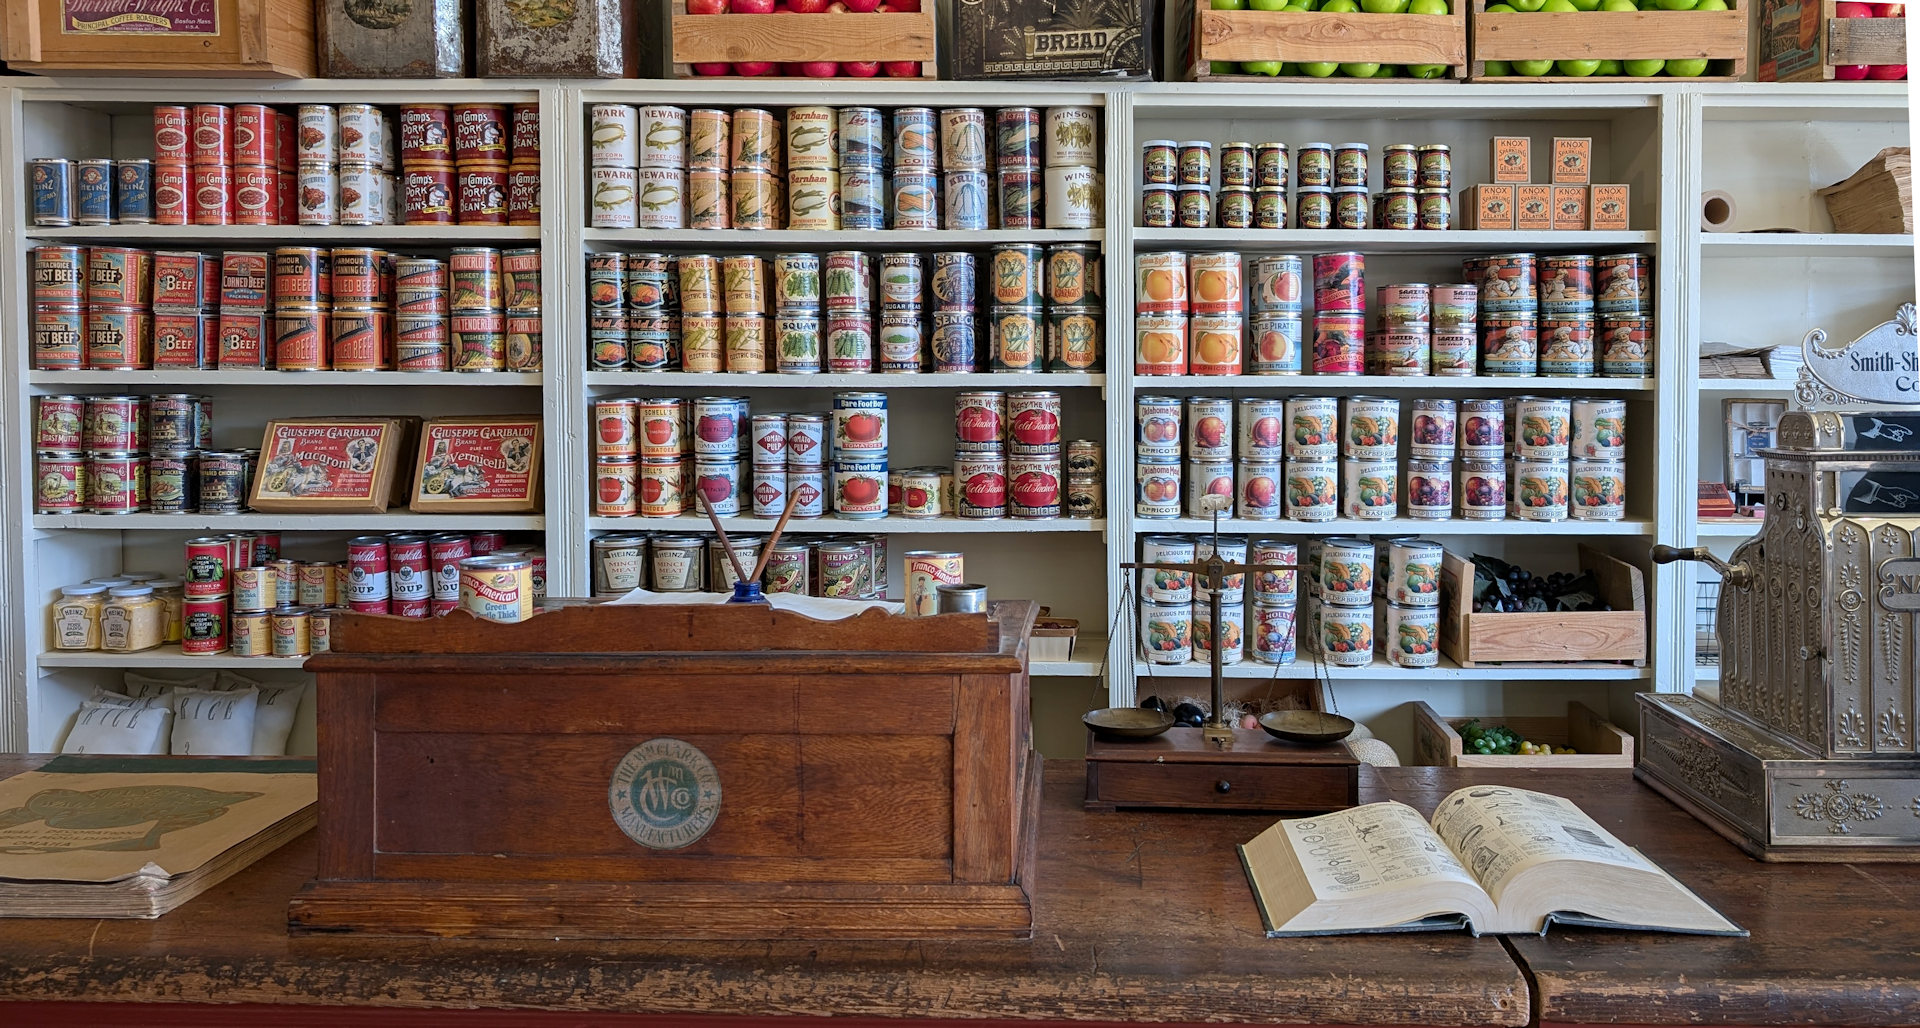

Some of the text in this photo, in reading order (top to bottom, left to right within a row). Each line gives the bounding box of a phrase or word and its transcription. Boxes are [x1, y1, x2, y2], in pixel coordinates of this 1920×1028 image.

[76, 20, 110, 31] PRINCIPAL
[110, 14, 134, 25] COFFEE
[136, 13, 168, 26] ROASTERS
[1036, 31, 1107, 53] BREAD
[463, 110, 488, 125] Camp's
[593, 108, 626, 118] EWARK
[402, 124, 425, 136] PORK
[458, 124, 483, 138] PORK
[456, 135, 483, 151] BEANS
[513, 134, 538, 149] BEANS
[1560, 141, 1584, 149] KNOX
[1499, 149, 1527, 157] SPARKLING
[1558, 150, 1587, 158] SPARKLING
[1000, 156, 1024, 165] SUGAR
[1499, 164, 1526, 172] GELATINE
[1558, 165, 1585, 174] GELATINE
[410, 173, 433, 188] Camp's
[468, 173, 493, 188] Camp's
[406, 186, 428, 200] PORK
[463, 186, 487, 201] PORK
[511, 185, 534, 200] PORK
[1522, 187, 1546, 195] KNOX
[460, 199, 487, 212] BEANS
[1482, 196, 1511, 205] SPARKLING
[1483, 211, 1509, 219] GELATINE
[1521, 211, 1548, 219] GELATINE
[786, 261, 819, 270] SQUAW
[885, 257, 921, 266] PIONEER
[157, 268, 184, 277] CORNED
[1264, 263, 1285, 273] LITTLE
[54, 269, 78, 281] BEEF
[96, 269, 117, 282] BEEF
[166, 275, 195, 290] BEEF.
[223, 276, 265, 288] CORNED BEEF
[782, 322, 817, 330] SQUAW
[882, 317, 918, 326] PIONEER
[1270, 321, 1295, 331] PIRATE
[157, 328, 184, 337] CORNED
[222, 327, 247, 337] CORNED
[51, 331, 75, 344] BEEF
[97, 331, 117, 344] BEEF
[166, 334, 195, 350] BEEF.
[230, 334, 259, 350] BEEF.
[873, 400, 884, 409] Boy
[1417, 401, 1454, 410] JUNE
[1470, 402, 1504, 412] JUNE
[1142, 406, 1170, 415] Oklahoma
[1014, 421, 1033, 430] Cold
[277, 426, 381, 440] GIUSEPPE GARIBALDI
[431, 426, 534, 440] GIUSEPPE GARIBALDI
[764, 434, 783, 442] TOMATO
[58, 434, 80, 443] MUTTON
[105, 434, 127, 443] MUTTON
[300, 438, 323, 446] BRAND
[455, 439, 477, 447] BRAND
[766, 442, 782, 451] PULP
[793, 443, 809, 452] PULP
[1011, 439, 1060, 453] Tomatoes
[294, 450, 352, 469] Macaroni
[449, 451, 506, 470] Vermicelli
[840, 463, 883, 472] Bare Foot Boy
[1142, 466, 1170, 476] Oklahoma
[1412, 462, 1448, 472] JUNE
[1469, 462, 1504, 472] JUNE
[966, 483, 986, 493] Cold
[1014, 483, 1033, 493] Cold
[102, 495, 126, 503] MUTTON
[758, 494, 774, 503] PULP
[1011, 501, 1060, 516] Tomatoes
[826, 553, 859, 561] HEINZ'S
[1261, 551, 1287, 561] HOLLY
[611, 566, 637, 574] MEAT
[394, 581, 423, 592] SOUP
[485, 603, 507, 612] Green
[498, 611, 518, 619] Thick
[1265, 611, 1290, 620] HOLLY
[179, 696, 236, 721] RICE
[81, 708, 145, 729] RICE
[619, 805, 714, 844] MANUFACTURERS
